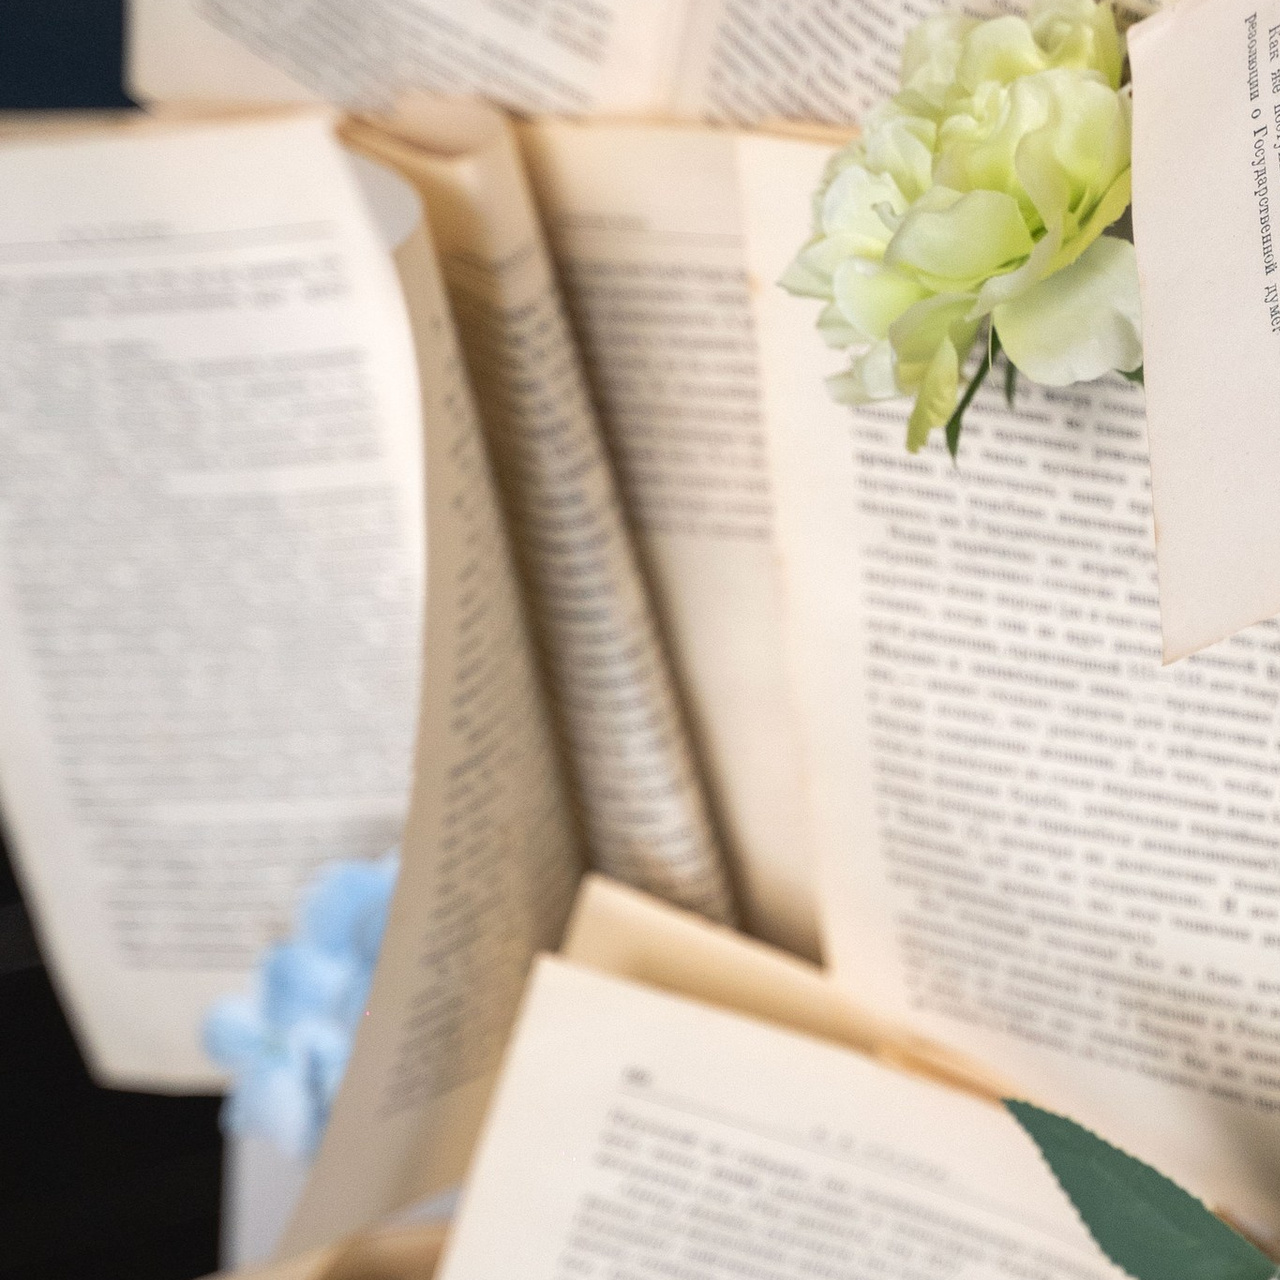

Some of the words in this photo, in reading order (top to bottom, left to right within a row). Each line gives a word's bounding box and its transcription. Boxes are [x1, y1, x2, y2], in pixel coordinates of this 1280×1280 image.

[1244, 12, 1259, 101] резолюции
[1251, 108, 1261, 120] о
[1251, 126, 1278, 276] Государственной
